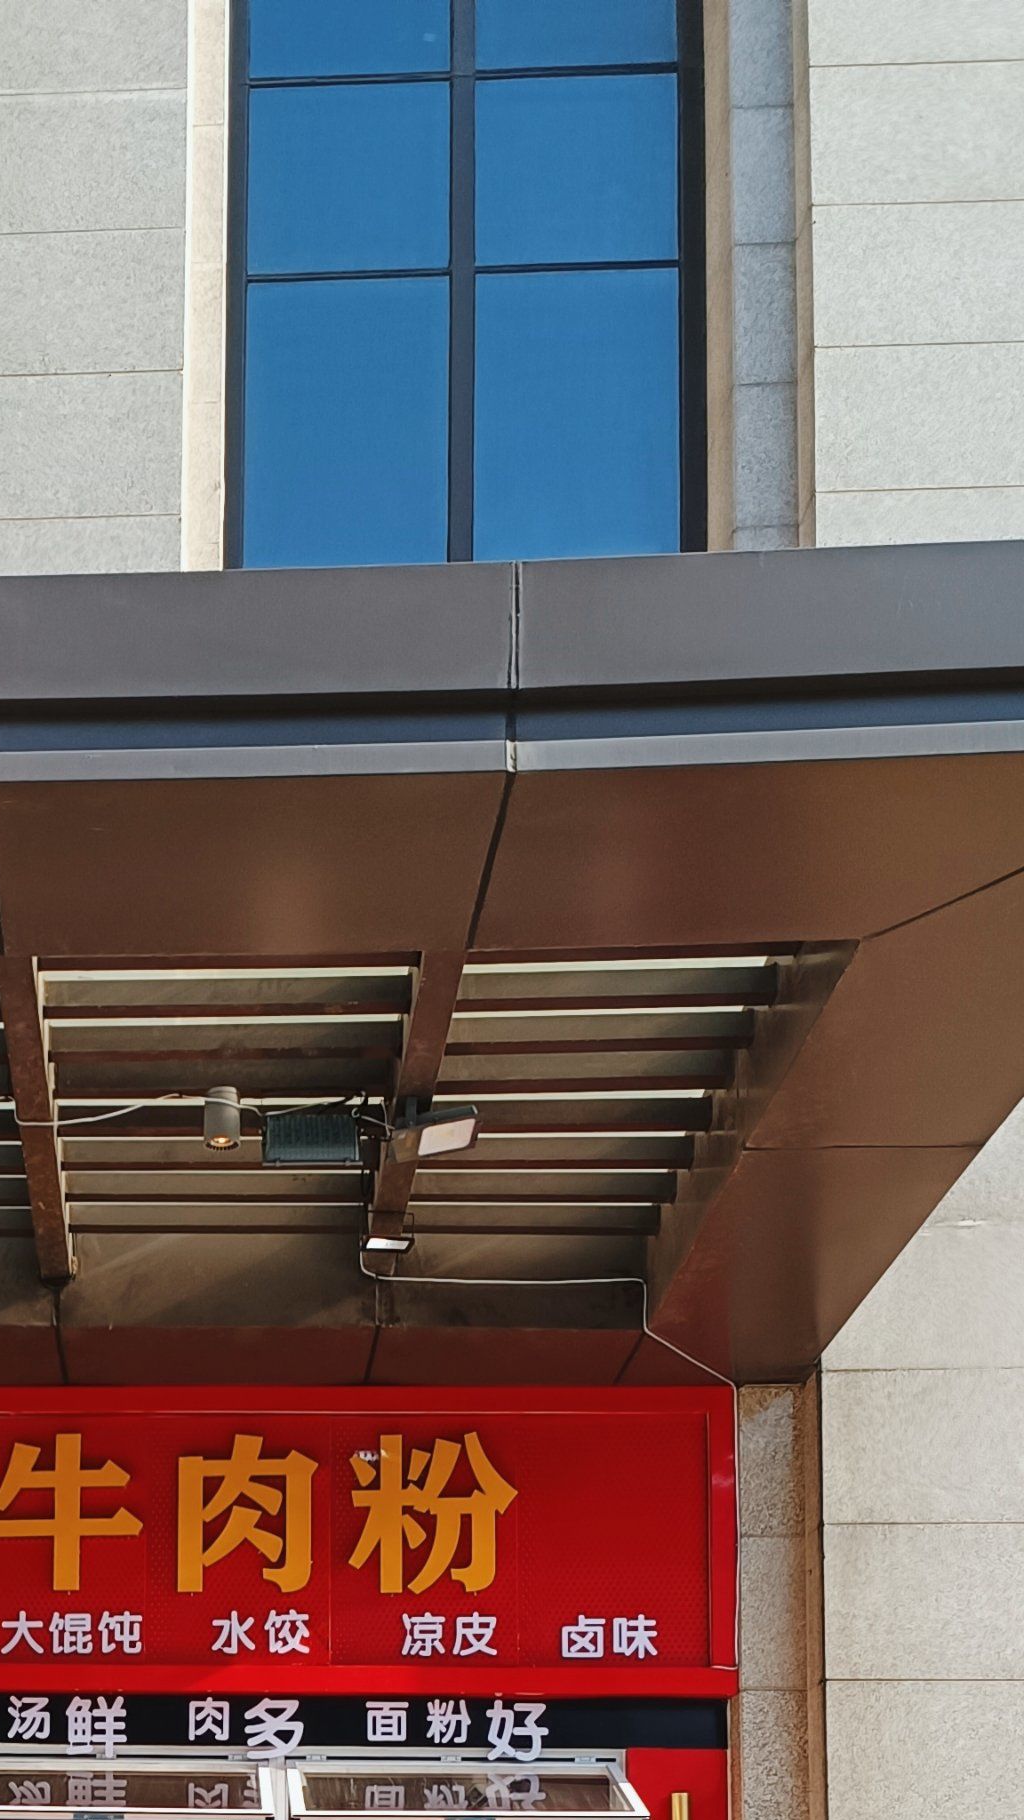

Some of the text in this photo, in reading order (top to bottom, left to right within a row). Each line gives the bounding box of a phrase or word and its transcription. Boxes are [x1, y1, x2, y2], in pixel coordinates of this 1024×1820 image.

[0, 1610, 144, 1656] 大馄饨
[211, 1610, 311, 1655] 水饺
[401, 1612, 498, 1658] 凉皮
[561, 1615, 658, 1660] 卤味
[6, 1695, 550, 1762] 汤鲜 肉多 面粉好
